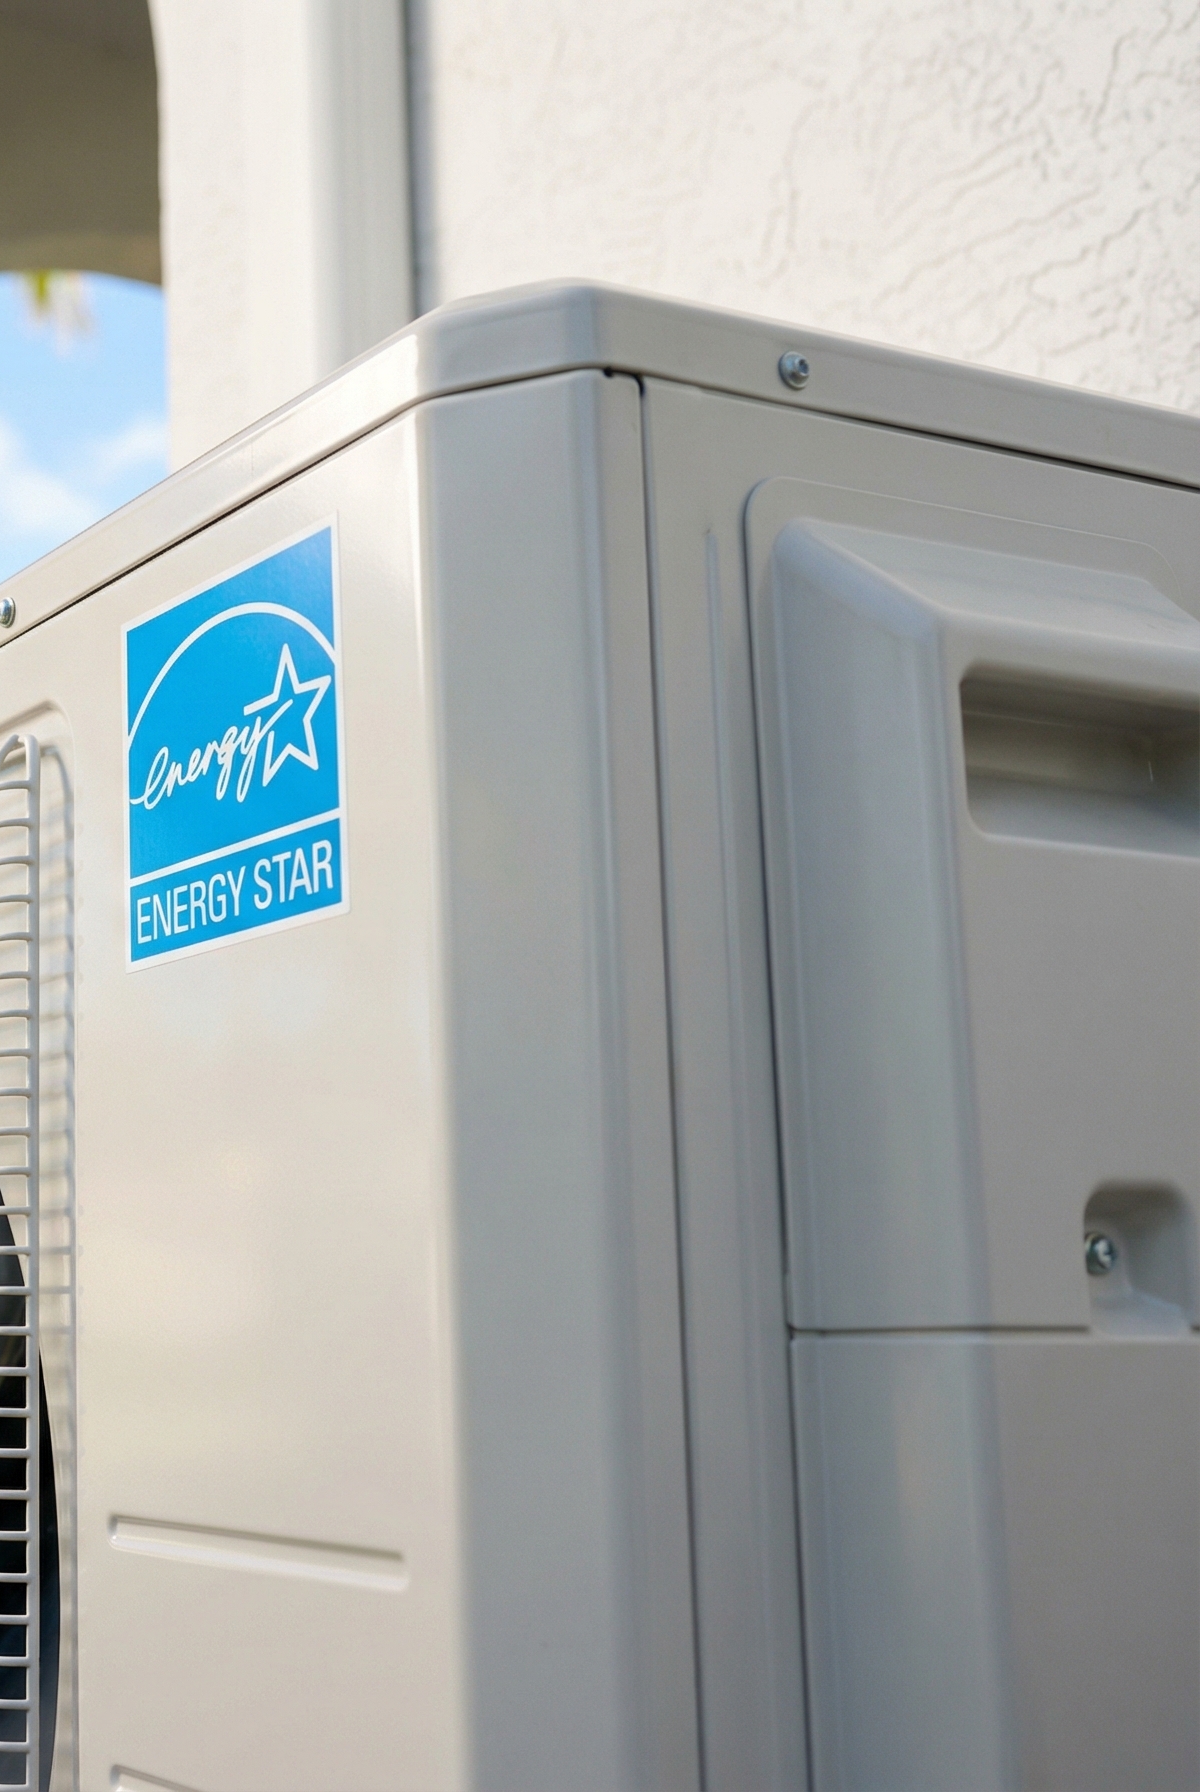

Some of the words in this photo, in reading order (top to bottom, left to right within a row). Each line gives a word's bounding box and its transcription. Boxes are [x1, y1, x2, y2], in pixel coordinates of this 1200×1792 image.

[130, 699, 293, 810] energy
[136, 865, 246, 945] ENERGY
[253, 839, 334, 910] STAR
